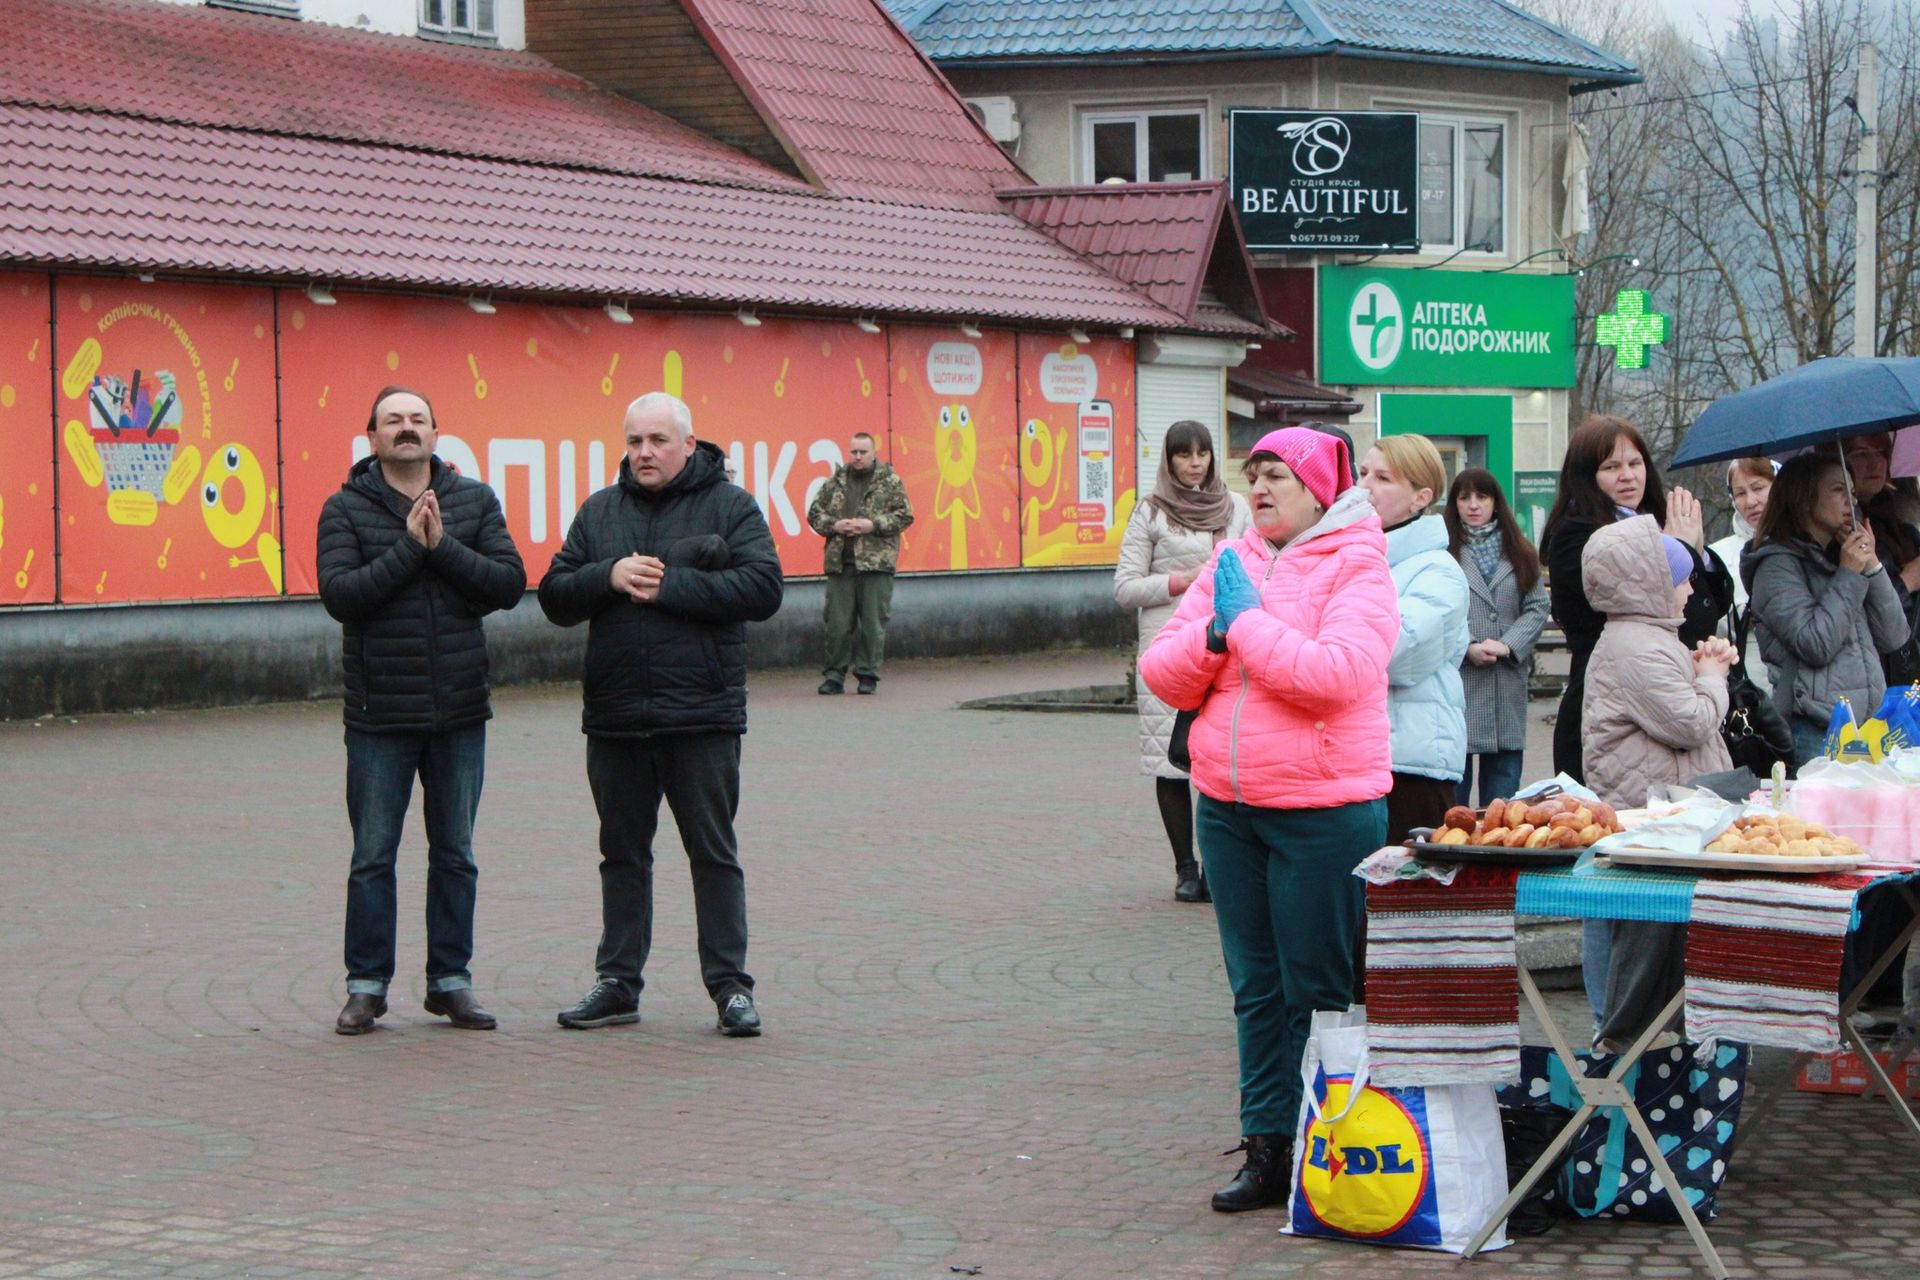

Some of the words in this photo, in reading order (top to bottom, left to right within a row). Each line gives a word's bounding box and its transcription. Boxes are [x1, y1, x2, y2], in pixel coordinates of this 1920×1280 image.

[1290, 179, 1325, 187] СТУДІЯ
[1242, 188, 1408, 214] BEAUTIFUL
[1298, 234, 1316, 242] 067
[1317, 234, 1329, 242] 73
[1330, 234, 1342, 242] 09
[1344, 234, 1360, 242] 227
[1412, 301, 1488, 326] АПТЕКА
[97, 303, 161, 333] КОПІЙОЧКА
[163, 314, 201, 368] ГРИВНЮ
[1412, 327, 1551, 355] ПОДОРОЖНИК
[934, 351, 953, 365] НОВІ
[954, 351, 976, 366] АКЦІЇ
